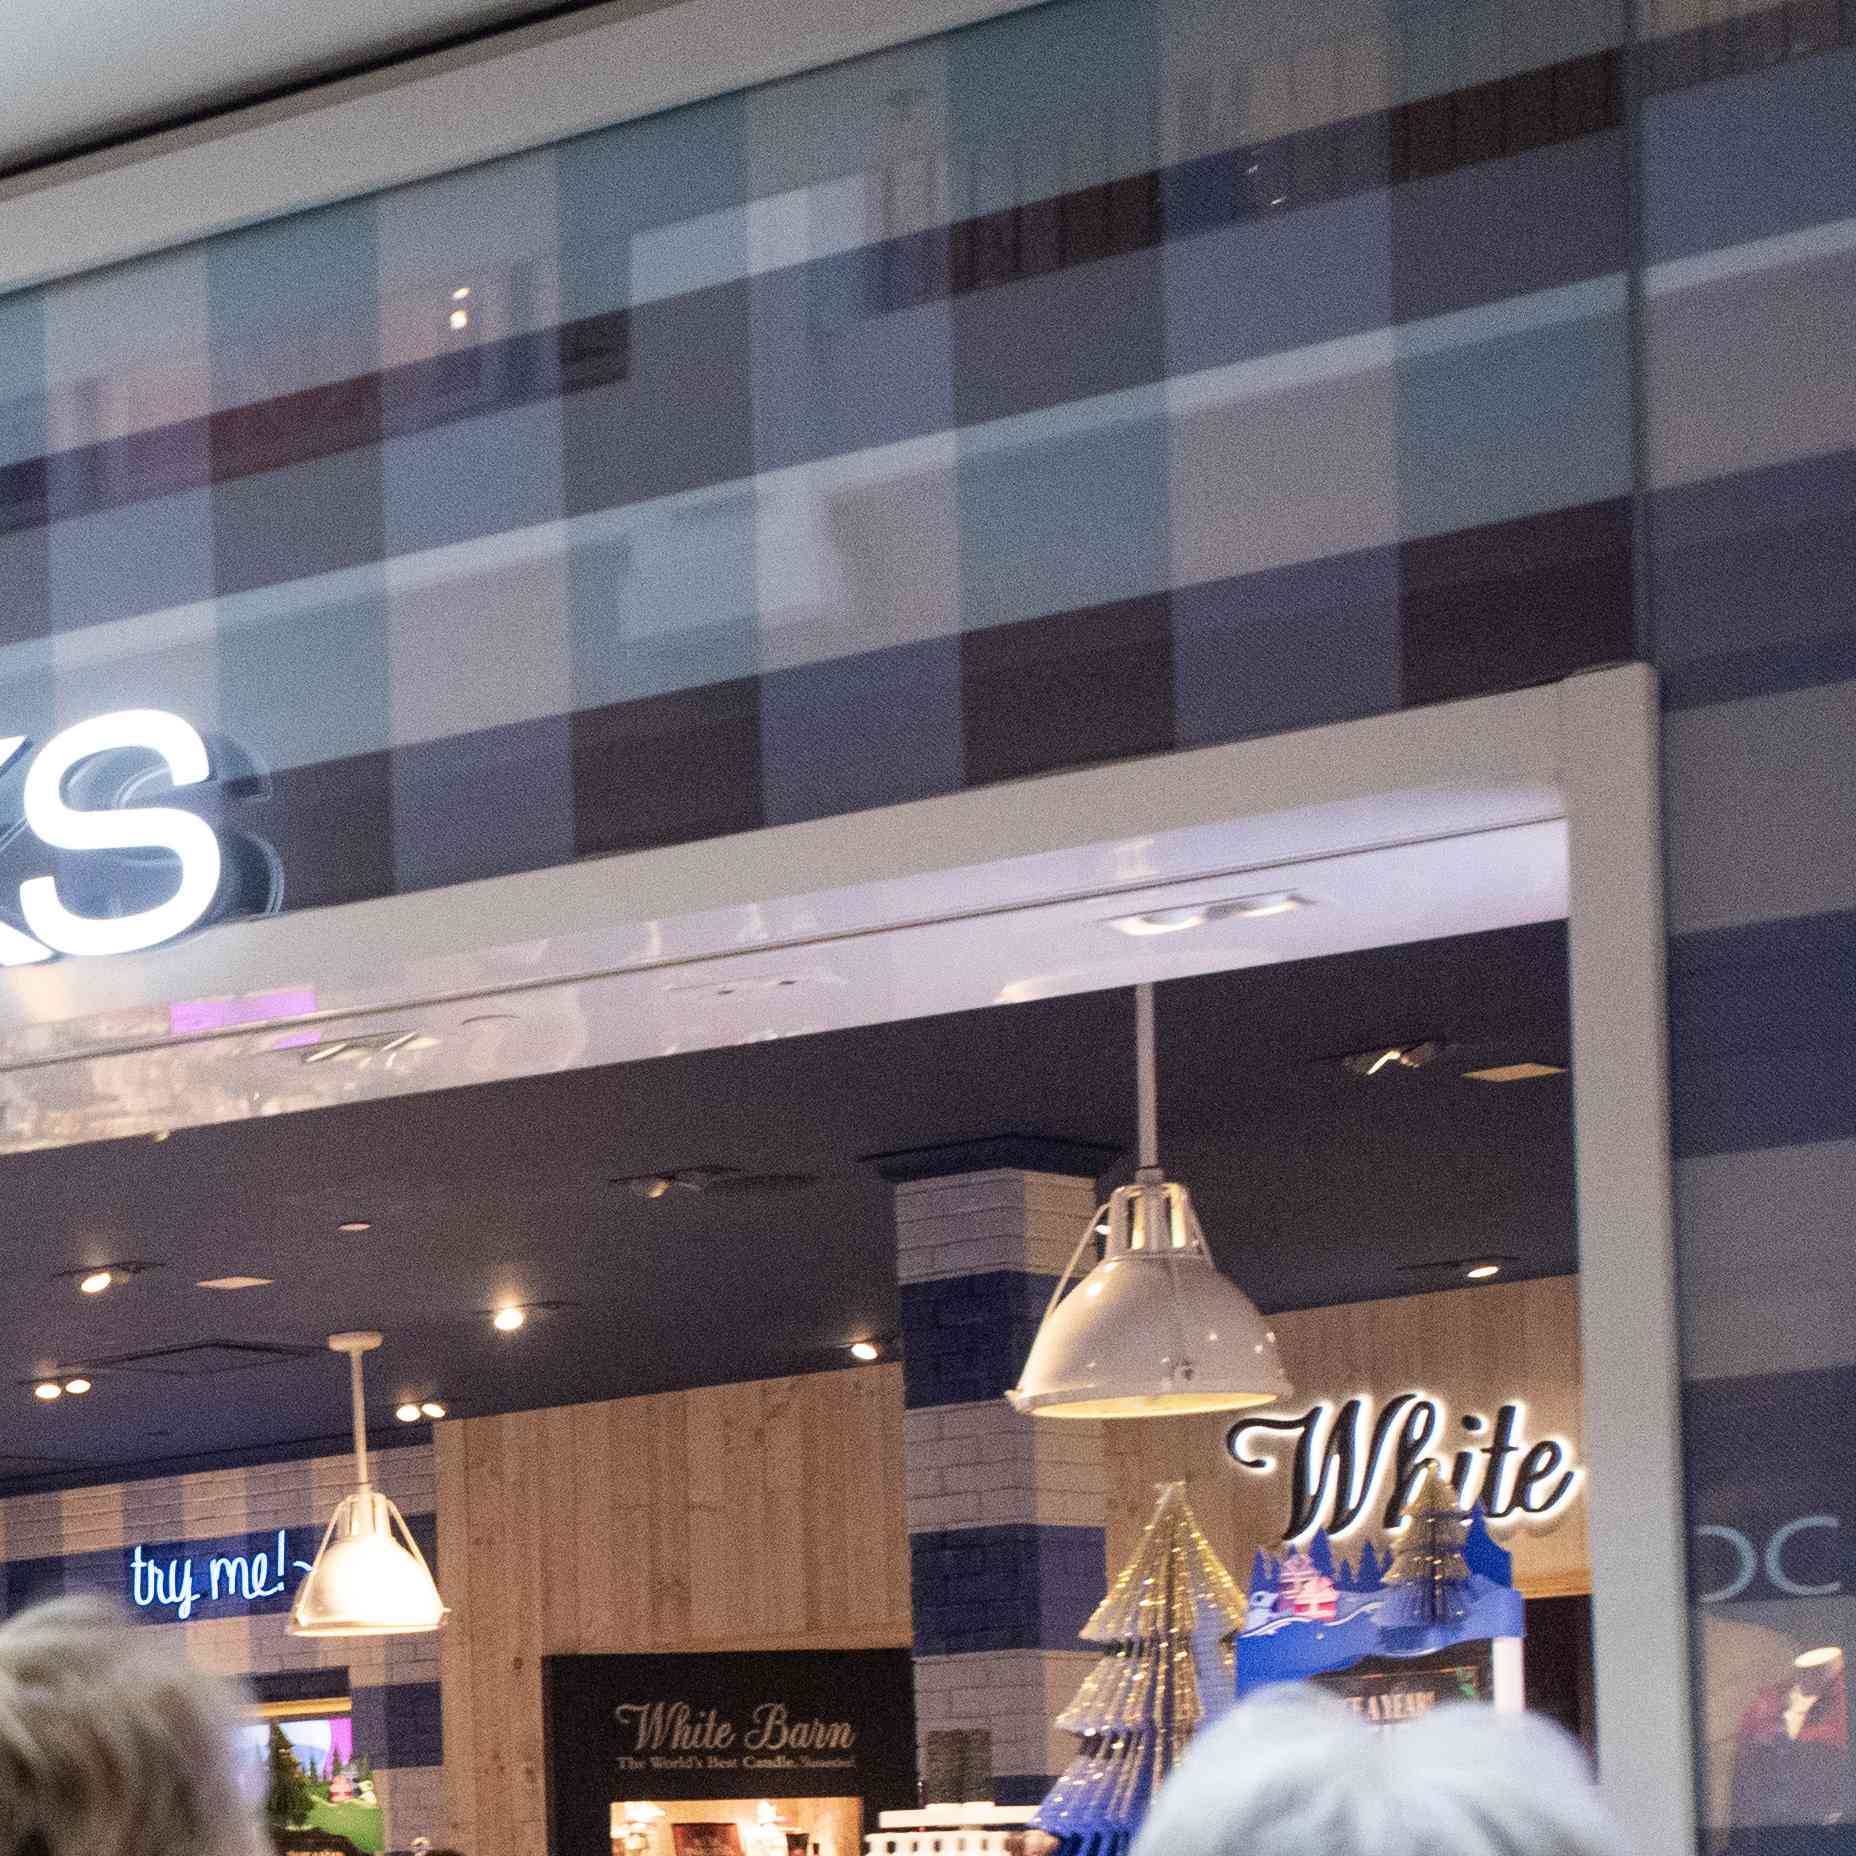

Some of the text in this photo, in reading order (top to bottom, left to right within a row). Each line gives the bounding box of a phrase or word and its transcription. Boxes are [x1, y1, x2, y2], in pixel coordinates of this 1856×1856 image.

[1226, 1392, 1574, 1541] White
[130, 1530, 285, 1619] try me!
[615, 1700, 856, 1751] White Barn
